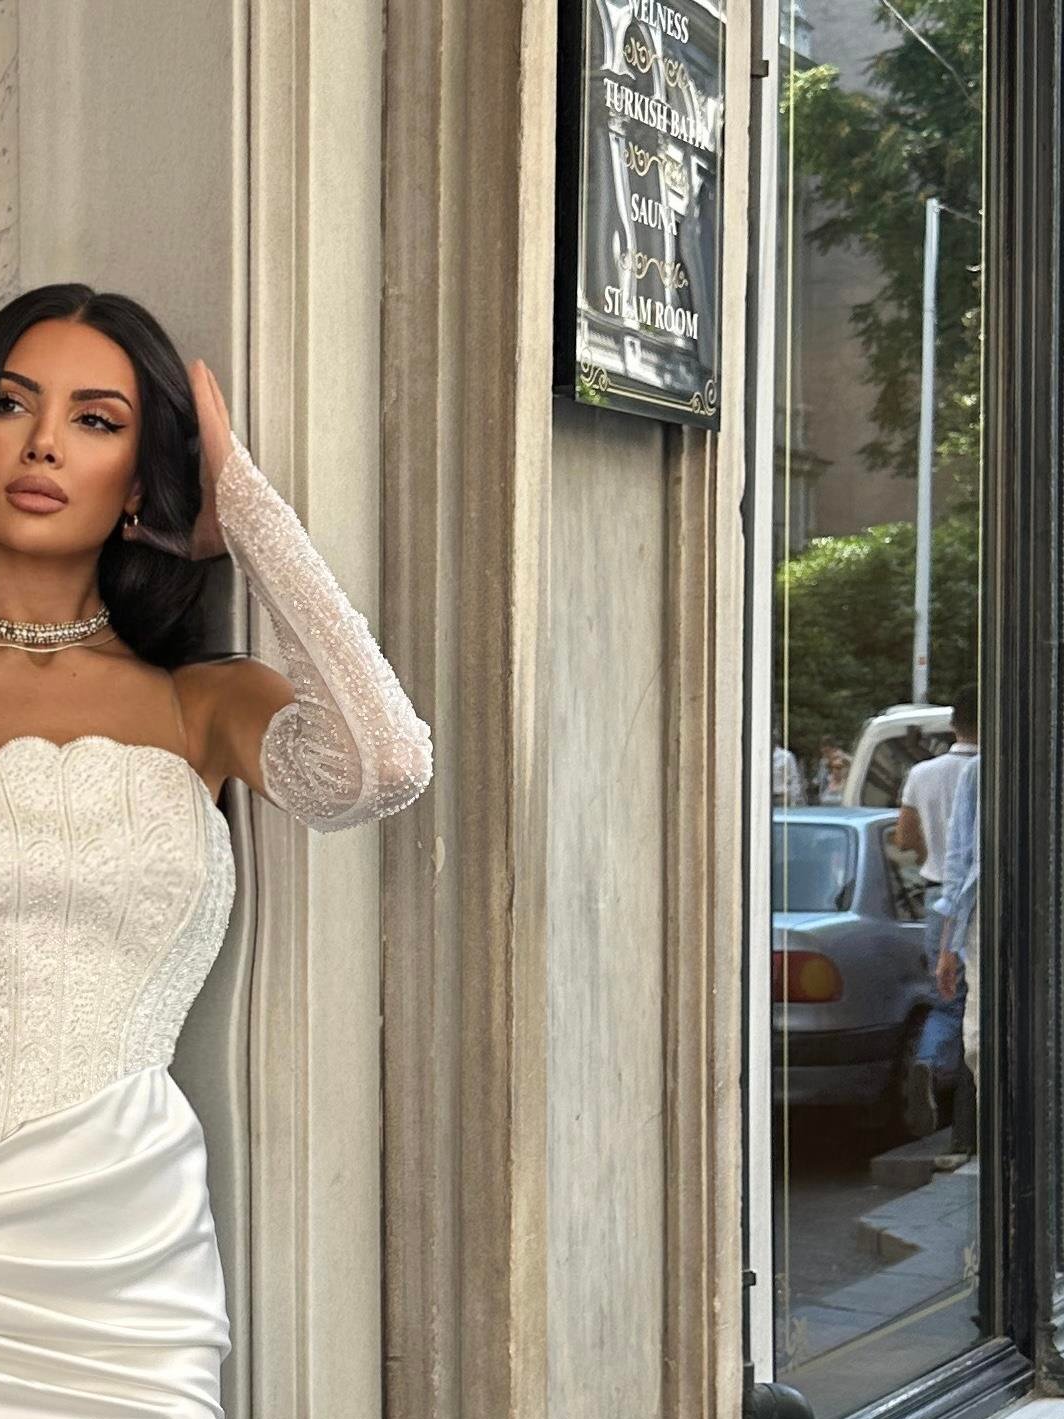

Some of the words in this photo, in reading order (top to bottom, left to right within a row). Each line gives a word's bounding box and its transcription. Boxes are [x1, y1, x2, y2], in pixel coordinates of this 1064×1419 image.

[603, 78, 671, 133] TURKISH
[630, 193, 678, 236] SAUNA
[603, 285, 653, 326] STEAM
[654, 301, 699, 340] ROOM
